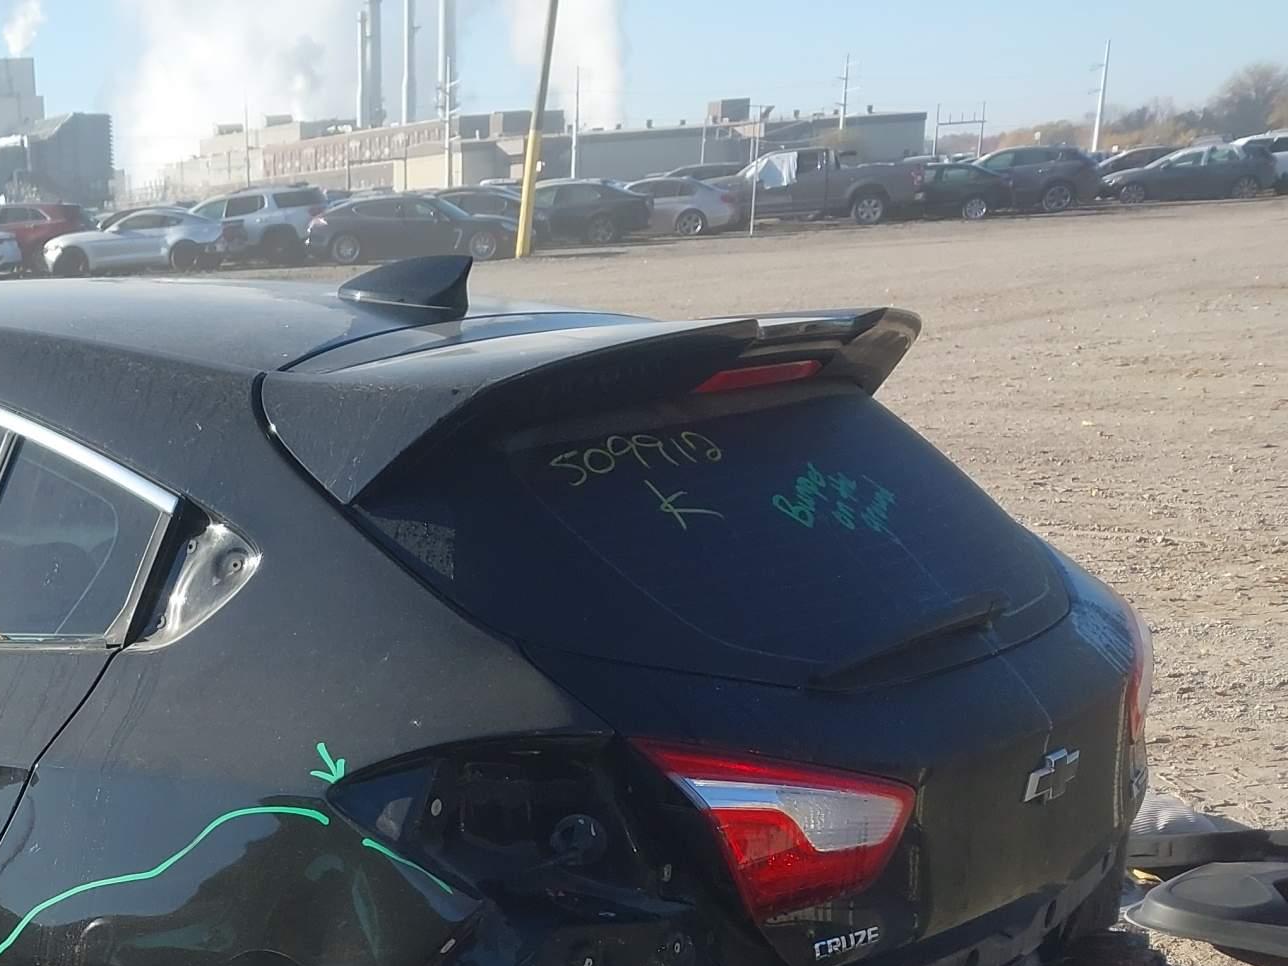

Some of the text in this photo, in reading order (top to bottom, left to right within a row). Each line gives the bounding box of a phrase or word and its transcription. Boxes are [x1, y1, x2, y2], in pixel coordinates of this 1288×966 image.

[549, 431, 723, 487] 509912
[643, 479, 725, 530] K
[814, 926, 880, 961] CRUZE
